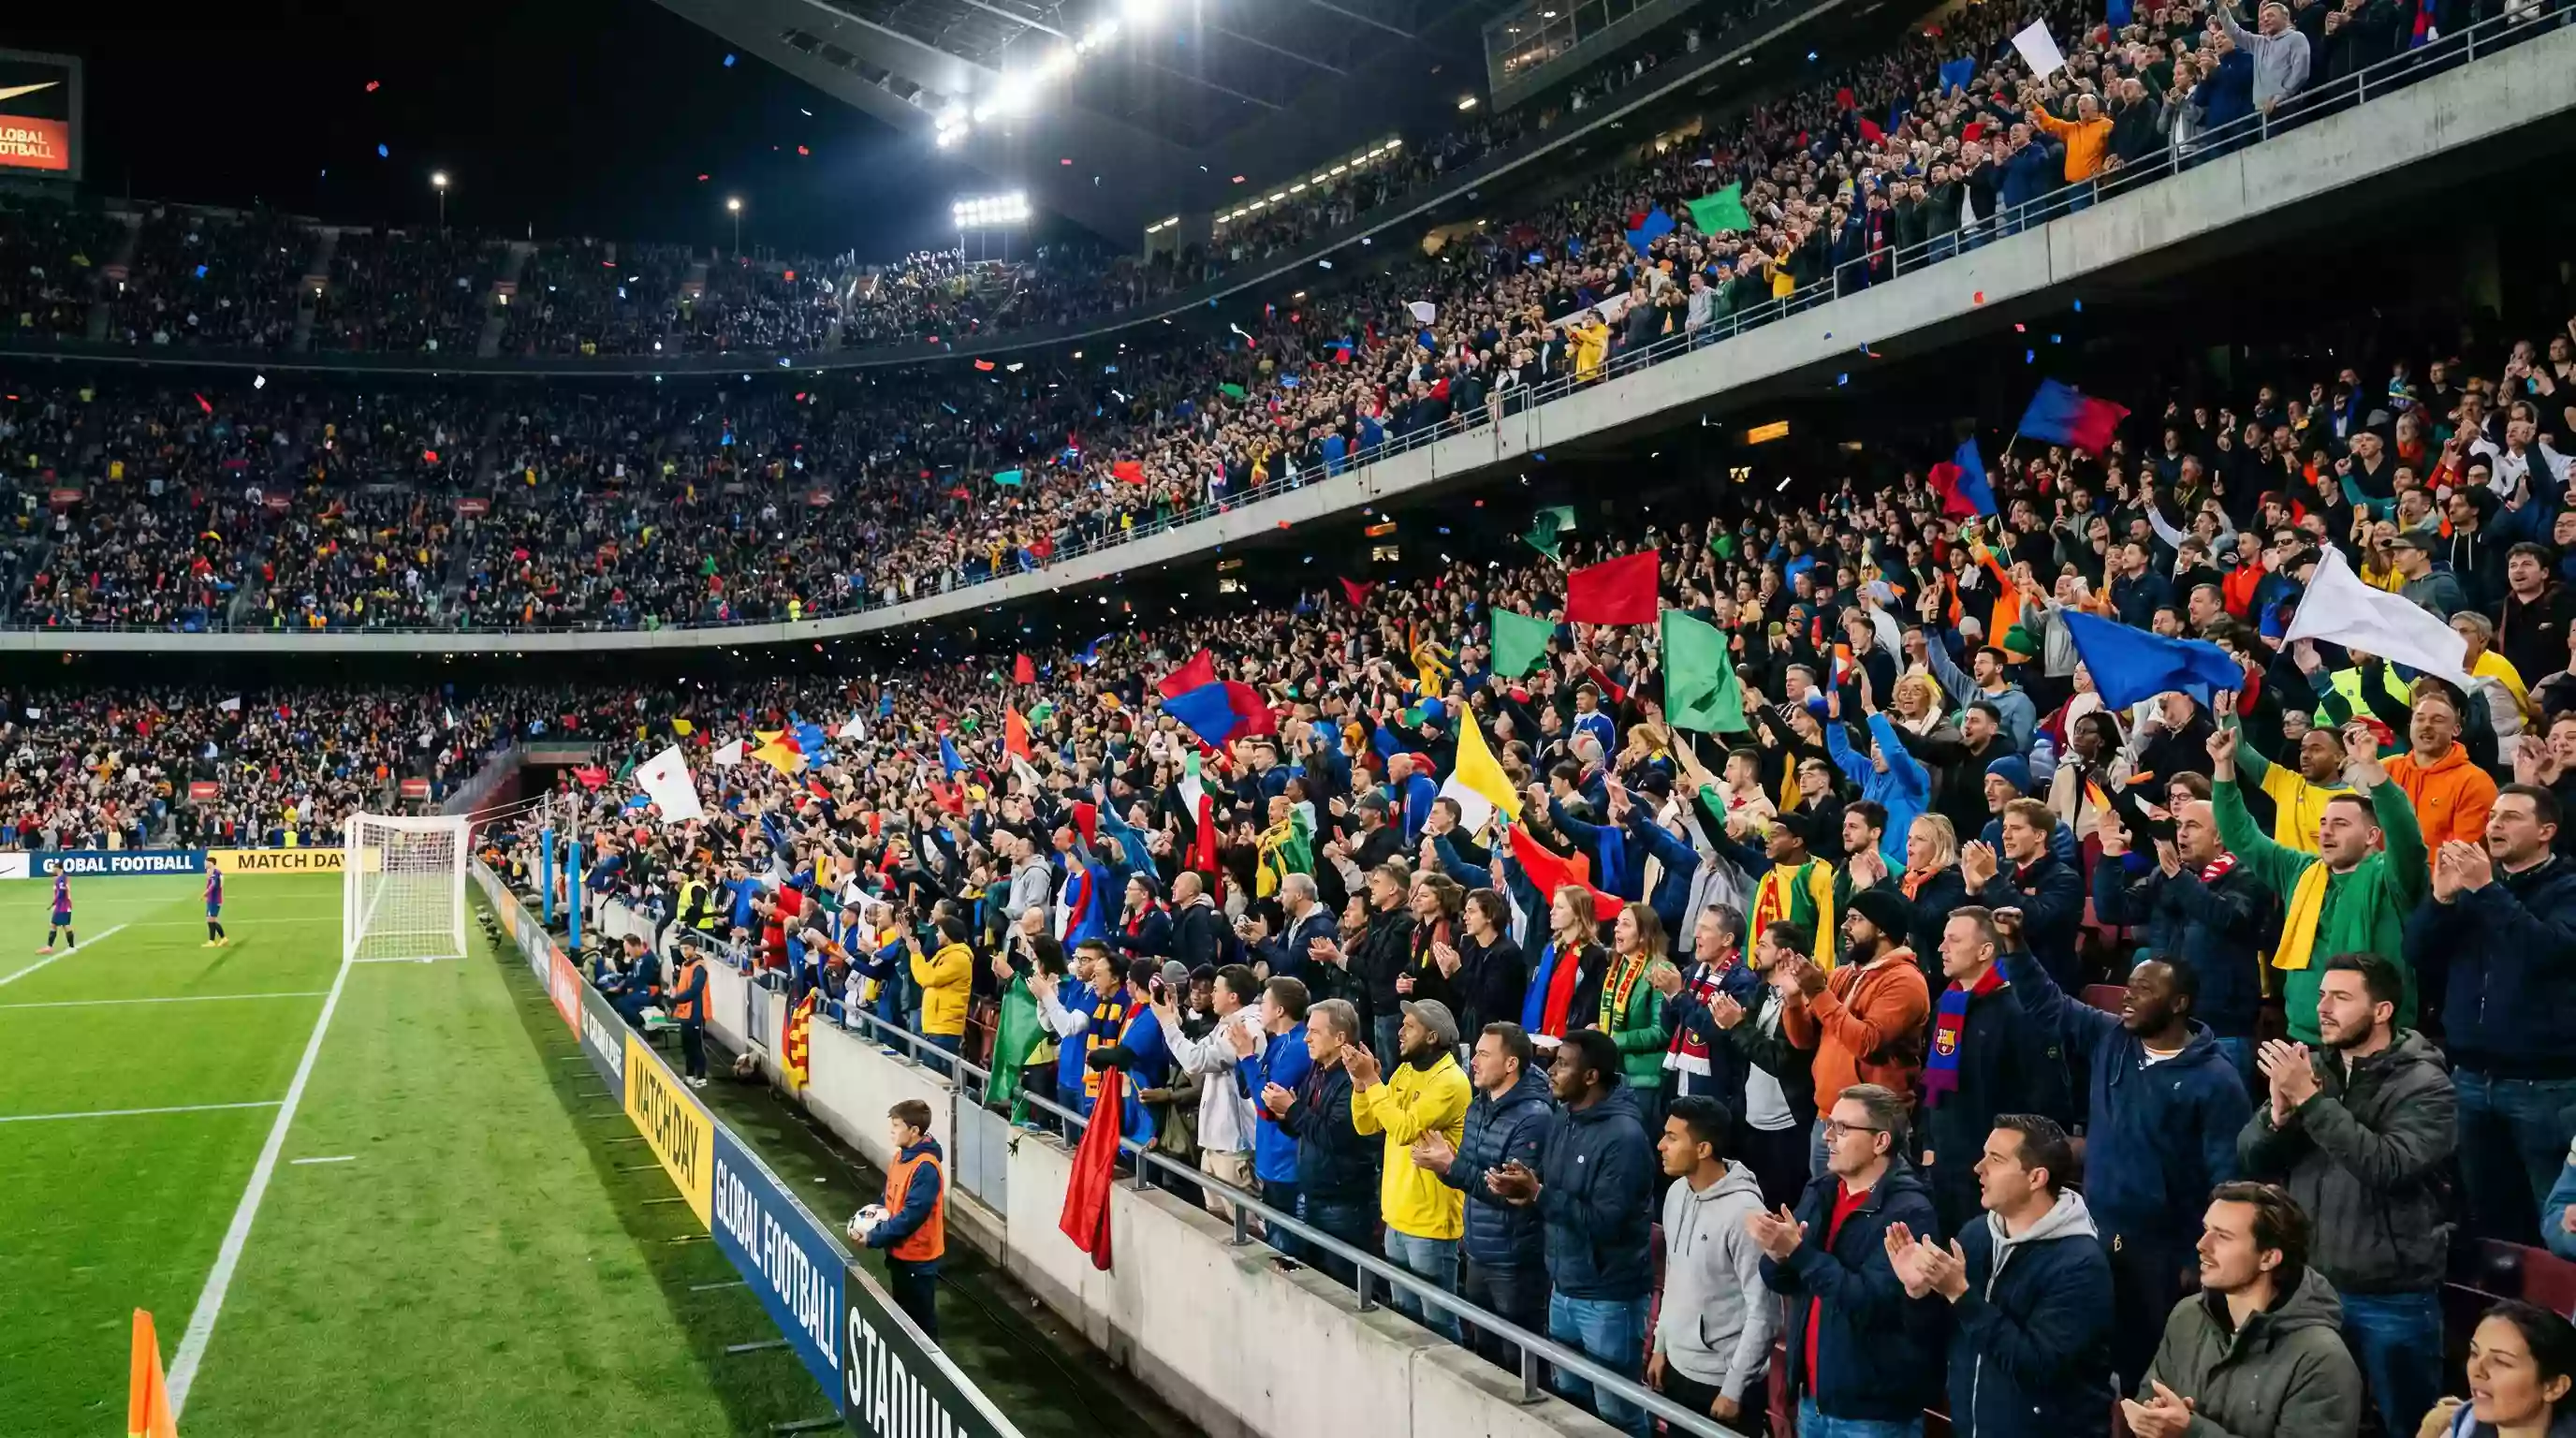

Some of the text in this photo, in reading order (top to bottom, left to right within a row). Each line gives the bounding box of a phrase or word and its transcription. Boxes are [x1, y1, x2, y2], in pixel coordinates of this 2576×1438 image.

[111, 856, 193, 871] FOOTBALL
[238, 854, 307, 869] MATCH
[634, 1056, 698, 1190] MATCH DAY
[716, 1158, 838, 1371] GLOBAL FOOTBALL
